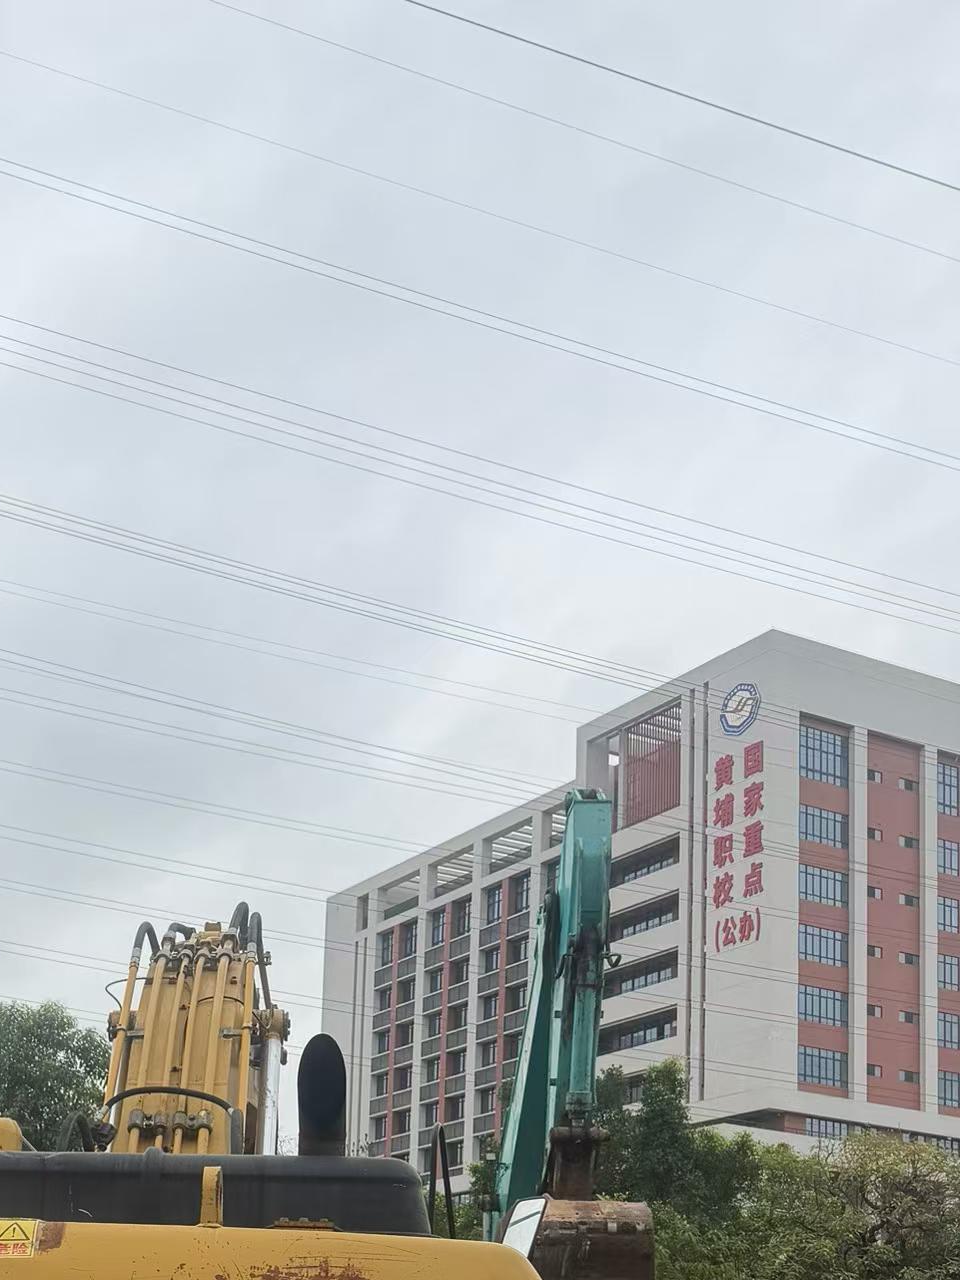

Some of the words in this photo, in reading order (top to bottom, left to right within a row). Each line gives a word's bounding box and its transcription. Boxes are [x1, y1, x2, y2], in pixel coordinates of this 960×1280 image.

[713, 754, 735, 909] 黄埔职校
[743, 740, 764, 898] 国家重点
